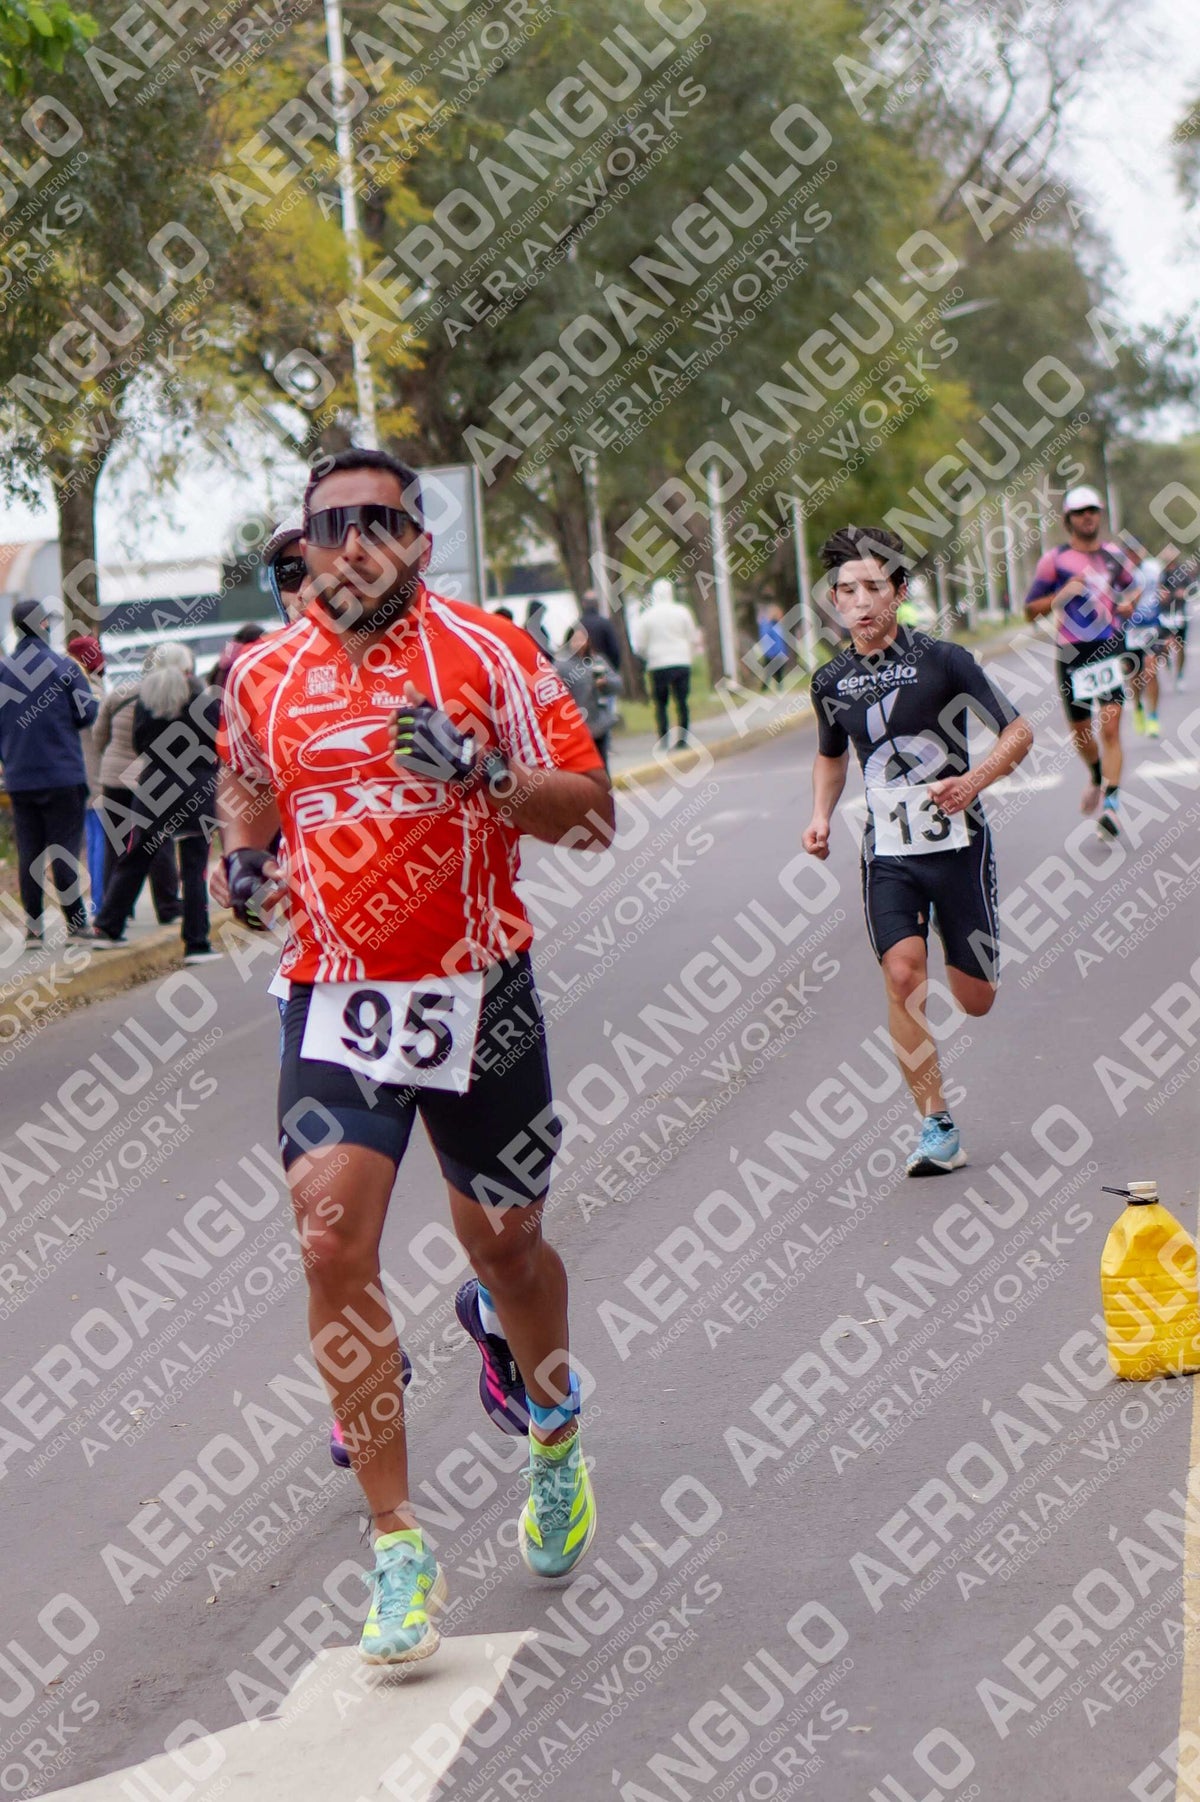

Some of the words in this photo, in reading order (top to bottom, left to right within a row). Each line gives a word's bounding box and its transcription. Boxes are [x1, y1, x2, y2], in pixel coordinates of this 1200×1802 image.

[836, 663, 917, 691] cervélo
[1084, 667, 1114, 692] 30
[296, 782, 447, 828] axo
[889, 799, 951, 845] 13
[340, 989, 456, 1070] 95
